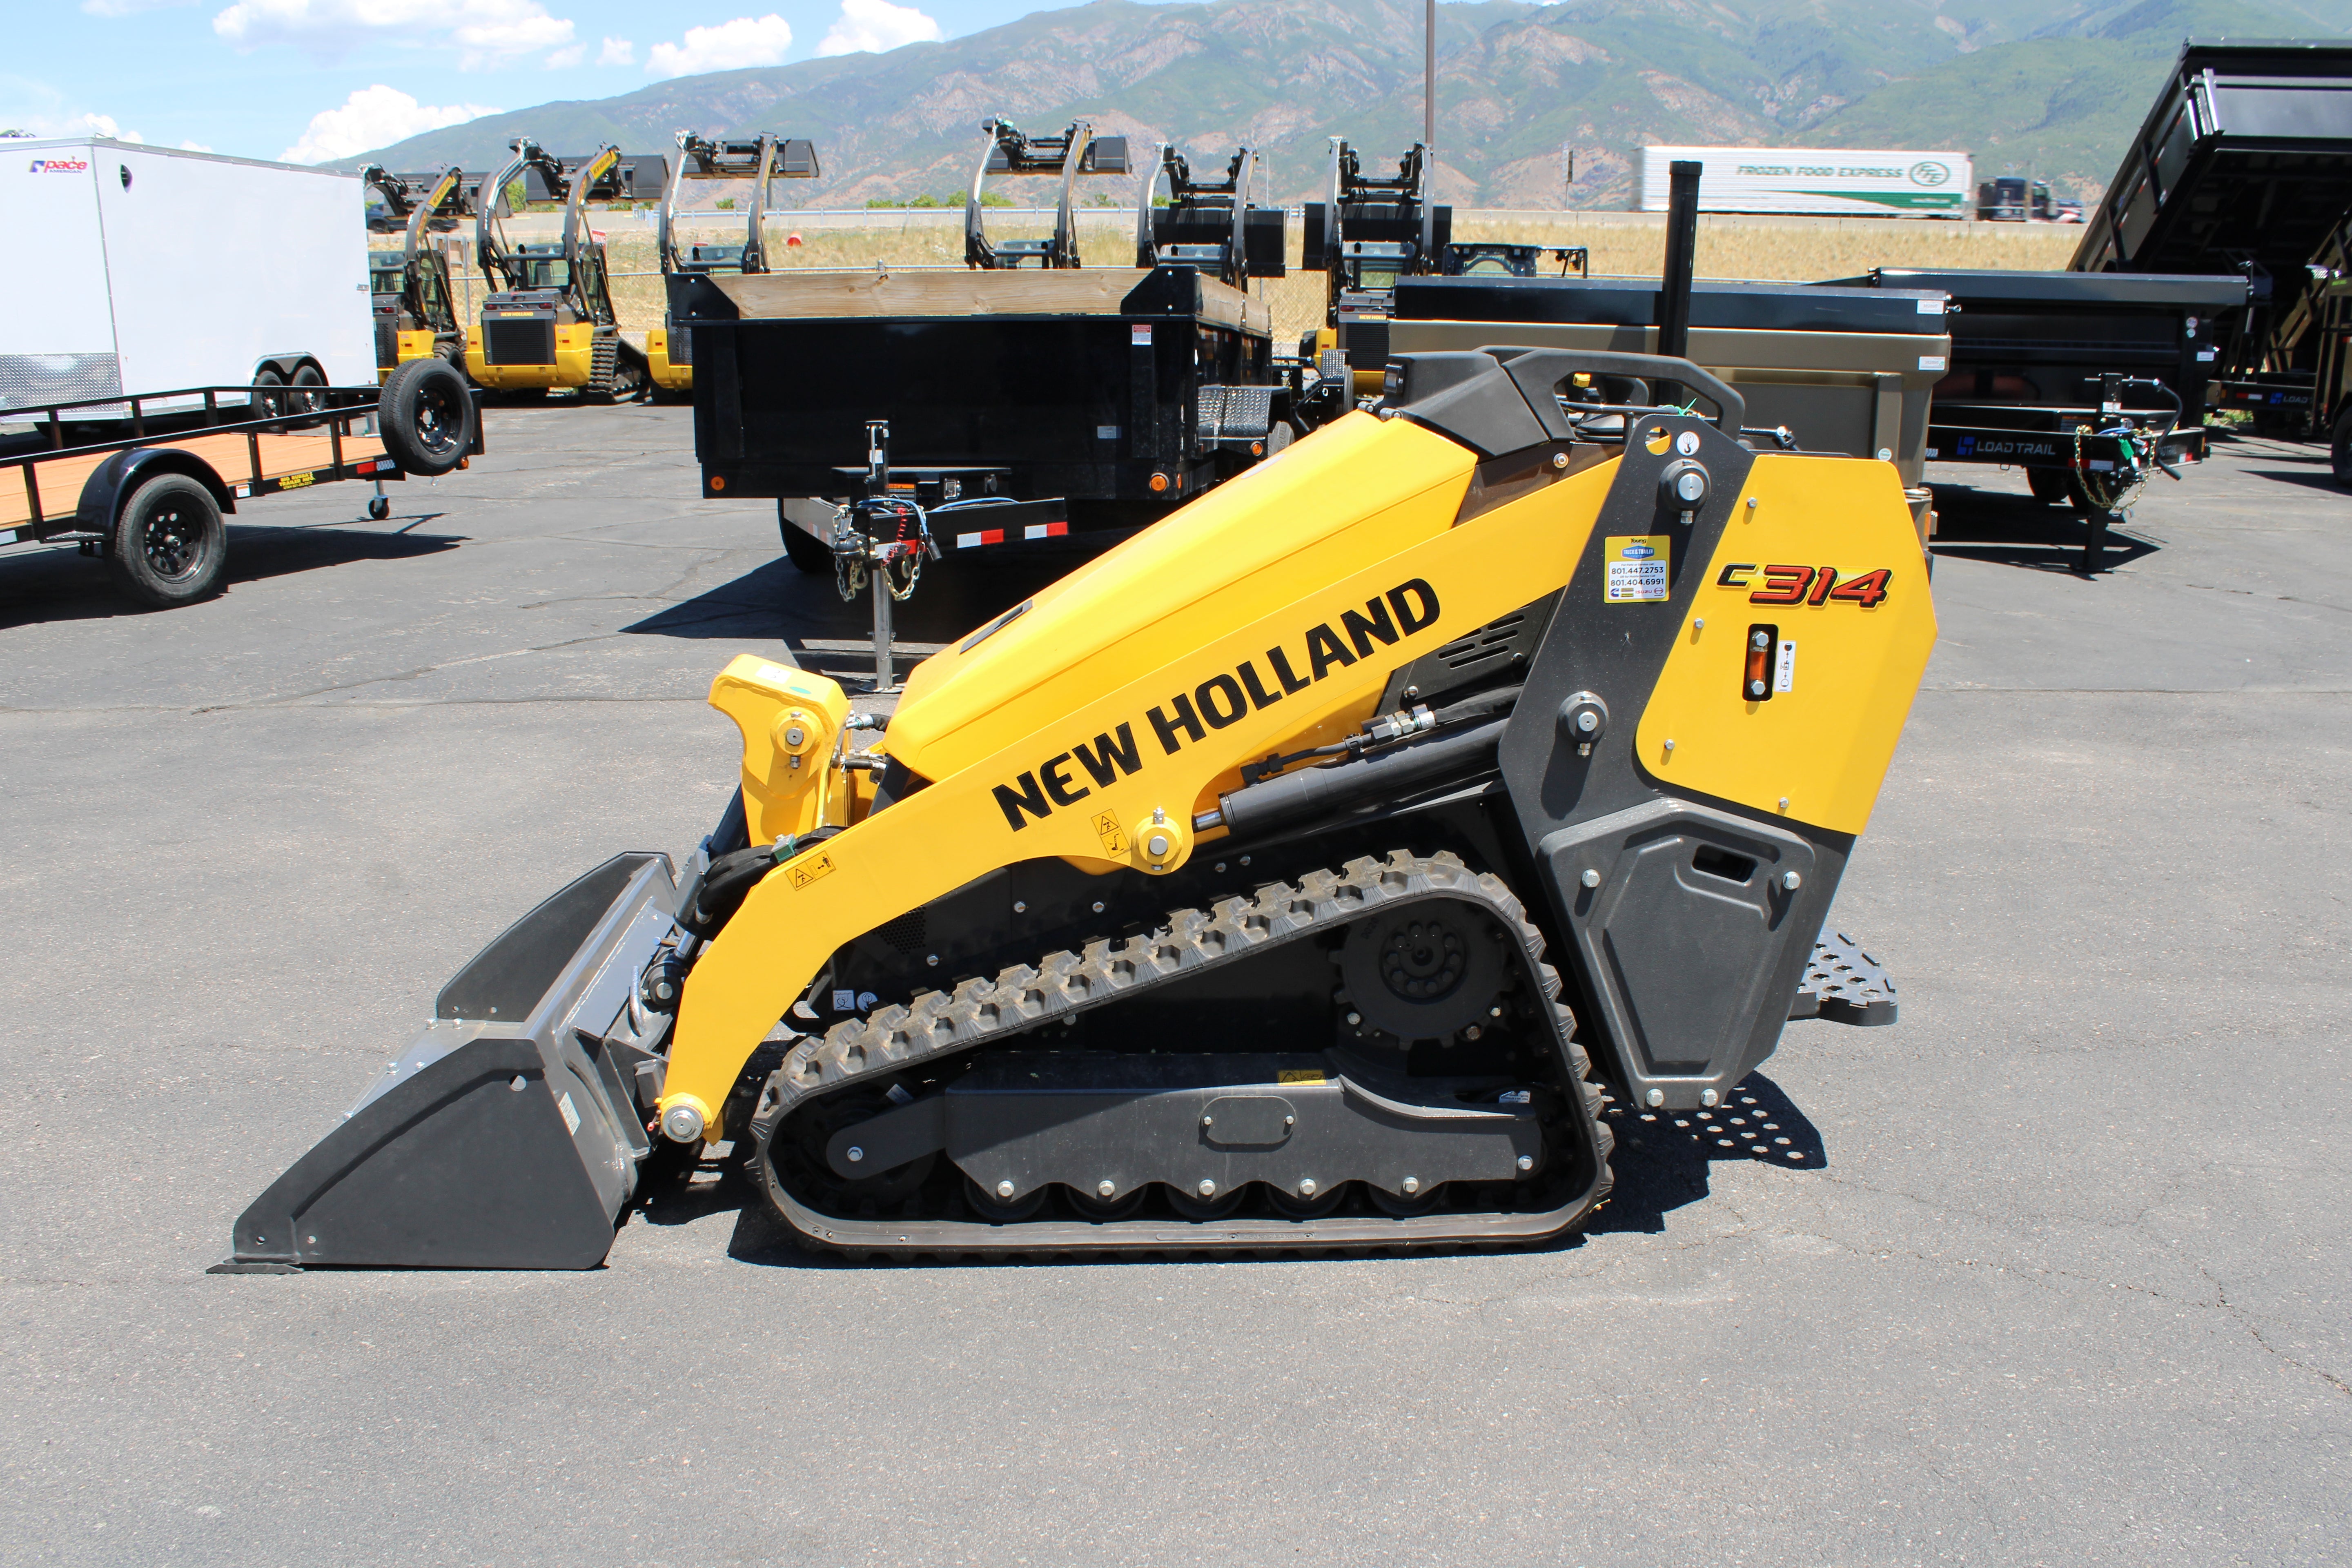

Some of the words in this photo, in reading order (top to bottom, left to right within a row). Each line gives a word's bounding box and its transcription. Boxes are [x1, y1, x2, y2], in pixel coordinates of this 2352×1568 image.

[44, 160, 87, 173] pace
[1738, 166, 1792, 176] FROZEN
[1796, 166, 1833, 176] FOOD
[1839, 167, 1904, 177] EXPRESS
[1976, 441, 2014, 453] LOAD
[2016, 443, 2056, 455] TRAIL
[992, 722, 1142, 831] NEW
[1146, 579, 1440, 755] HOLLAND
